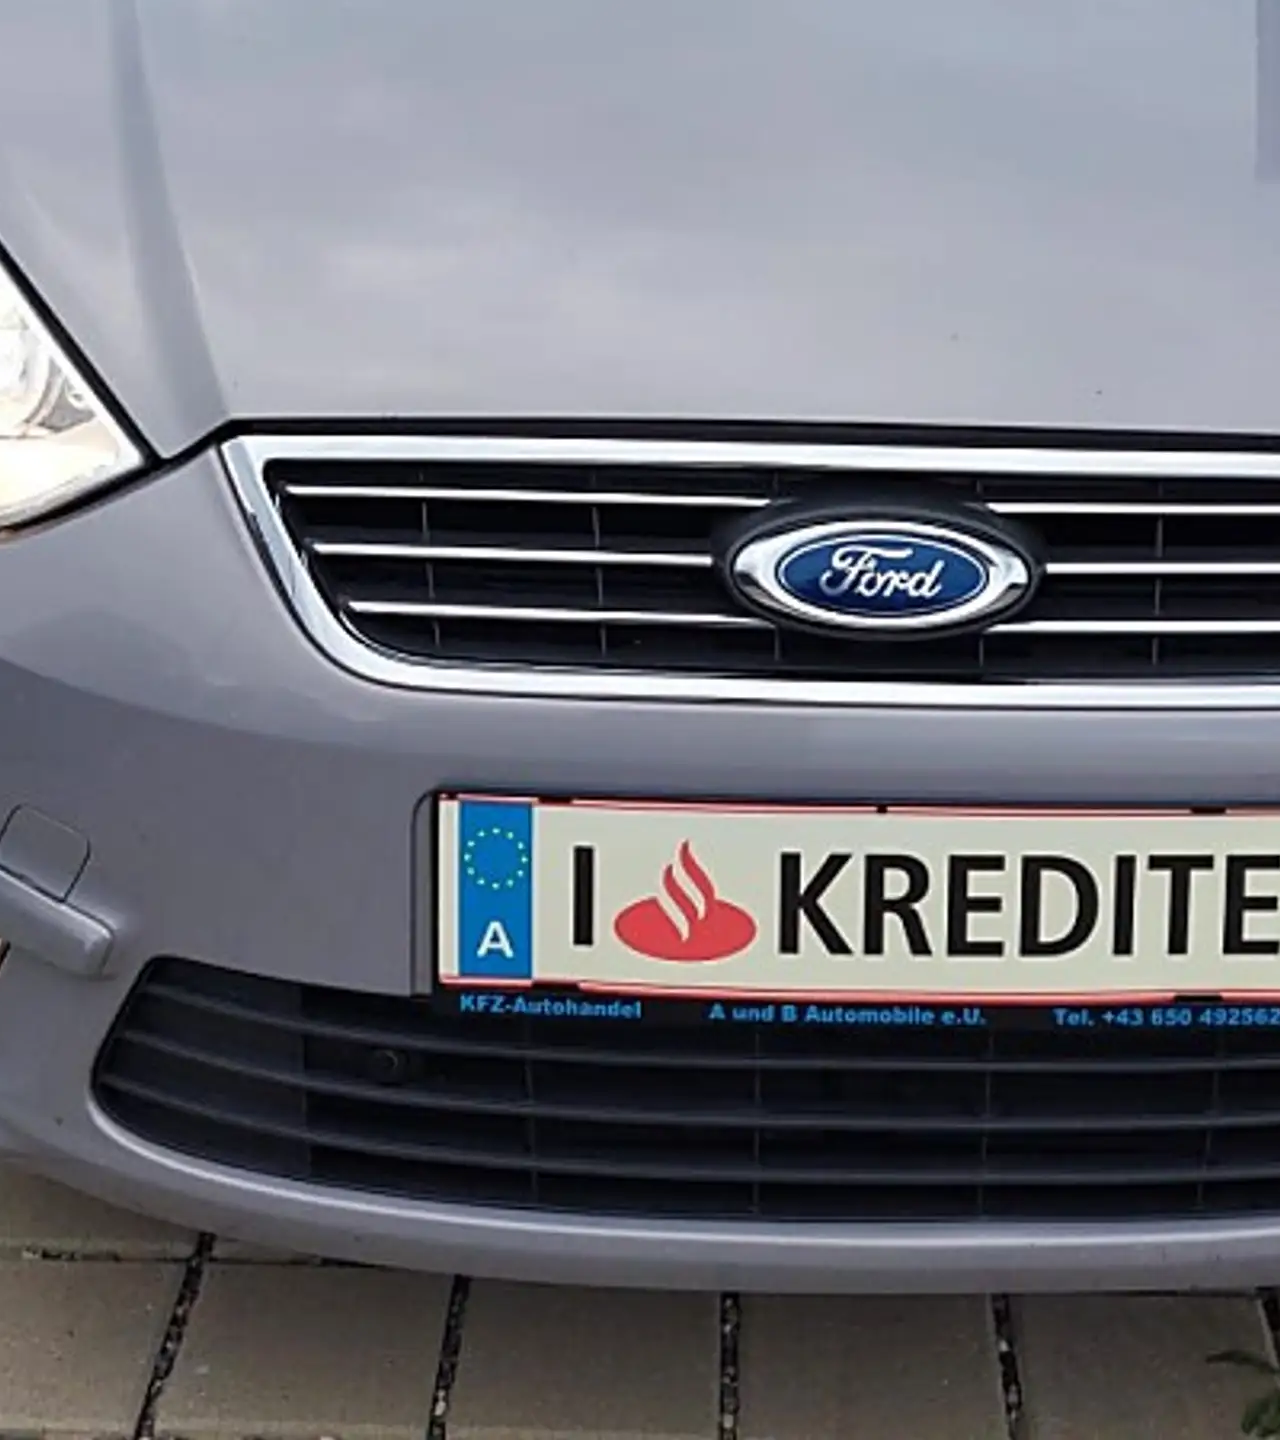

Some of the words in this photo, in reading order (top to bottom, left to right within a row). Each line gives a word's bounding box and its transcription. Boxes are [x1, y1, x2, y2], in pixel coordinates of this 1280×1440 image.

[819, 545, 946, 599] Ford
[572, 846, 595, 946] I
[477, 921, 515, 958] A
[460, 994, 642, 1020] KFZ-Autohandel
[709, 1005, 726, 1020] A
[733, 1005, 775, 1021] und
[782, 1006, 798, 1023] B
[804, 1004, 936, 1025] Automobile
[1053, 1008, 1094, 1026] Tel.
[1102, 1009, 1144, 1026] +43
[1151, 1009, 1191, 1027] 650
